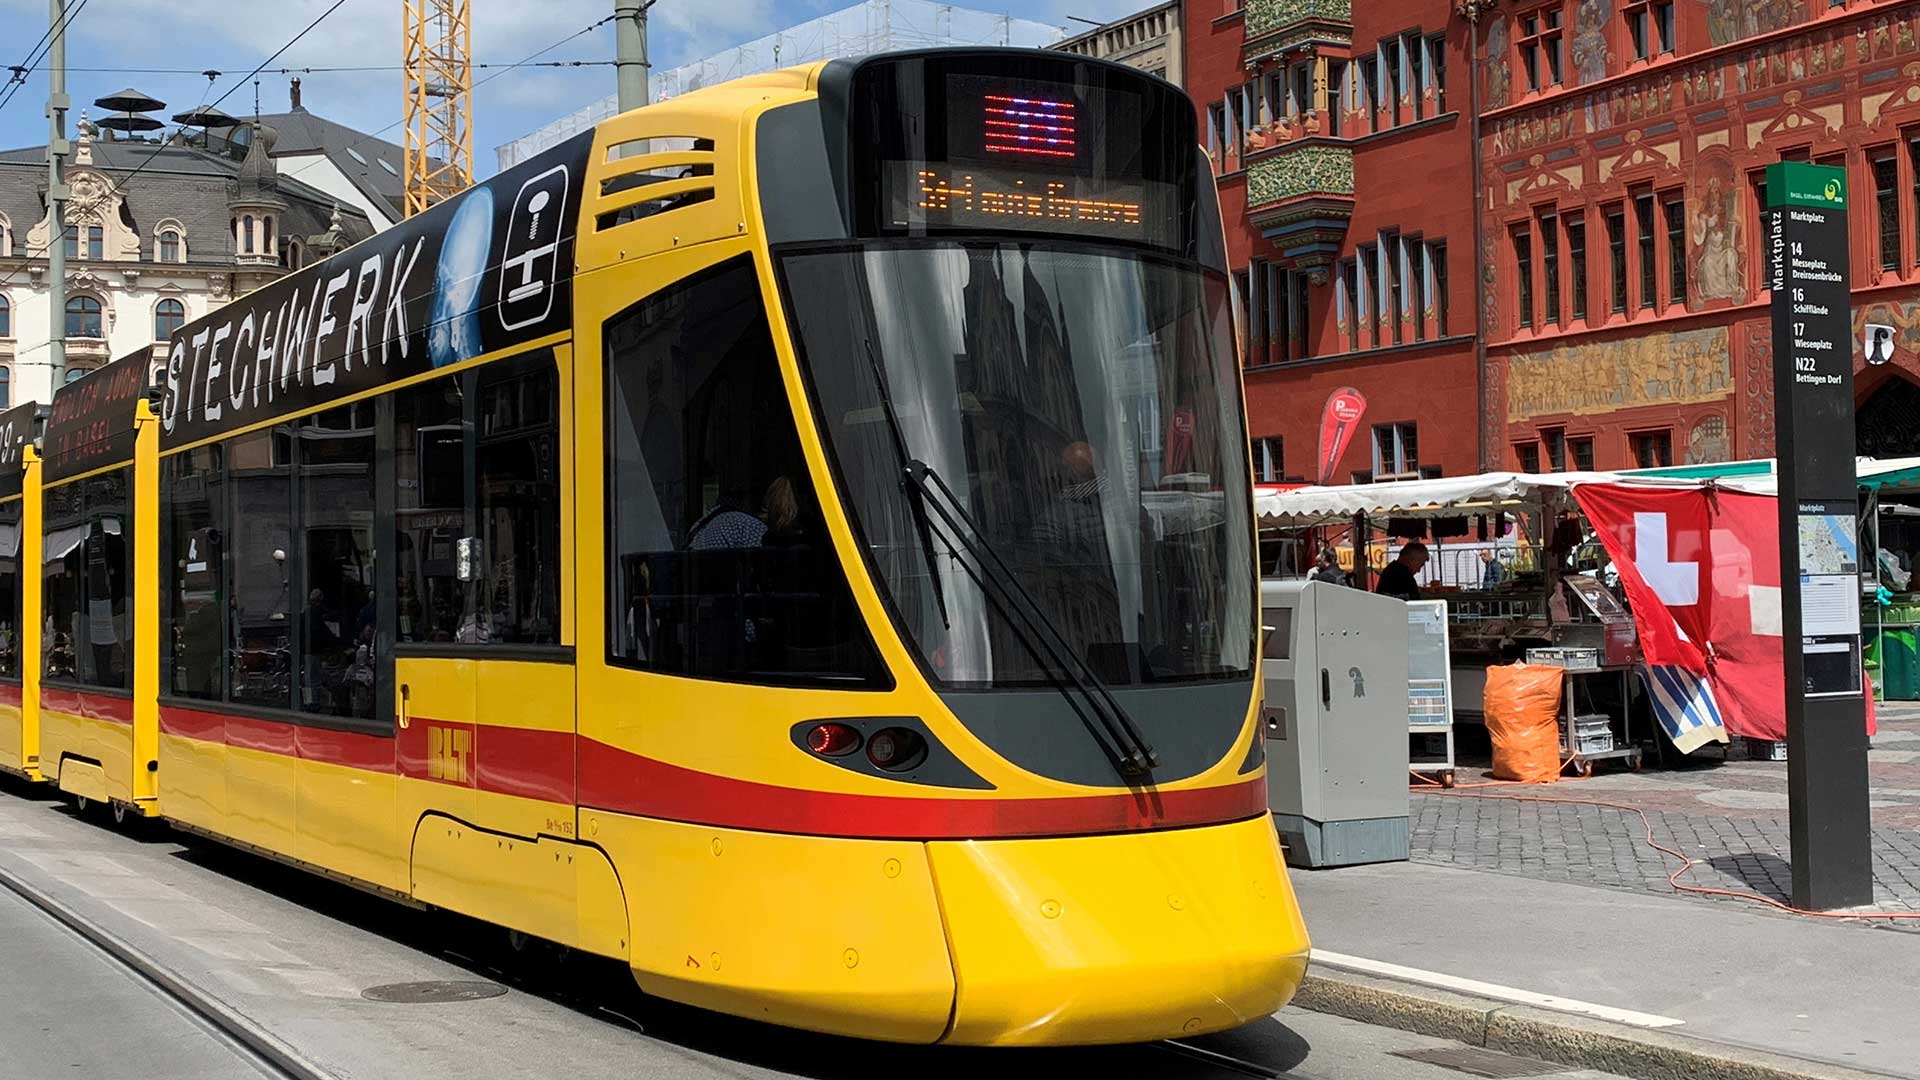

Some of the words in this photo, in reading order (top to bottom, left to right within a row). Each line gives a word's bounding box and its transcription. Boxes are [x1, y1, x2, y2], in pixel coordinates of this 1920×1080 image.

[1790, 211, 1825, 223] Marktplatz
[1770, 211, 1785, 291] Marktplatz
[1790, 241, 1803, 256] 14
[1792, 258, 1827, 270] Messeplatz
[1792, 269, 1842, 282] Dreirosenbrücke
[1792, 288, 1804, 302] 16
[1793, 304, 1829, 315] Schifflände
[161, 234, 426, 438] STECHWERK
[1793, 322, 1805, 336] 17
[1794, 338, 1833, 351] Wiesenplatz
[1795, 357, 1816, 371] N22
[1796, 373, 1827, 386] Bettingen
[1827, 375, 1842, 384] Dorf
[427, 725, 473, 784] BLT
